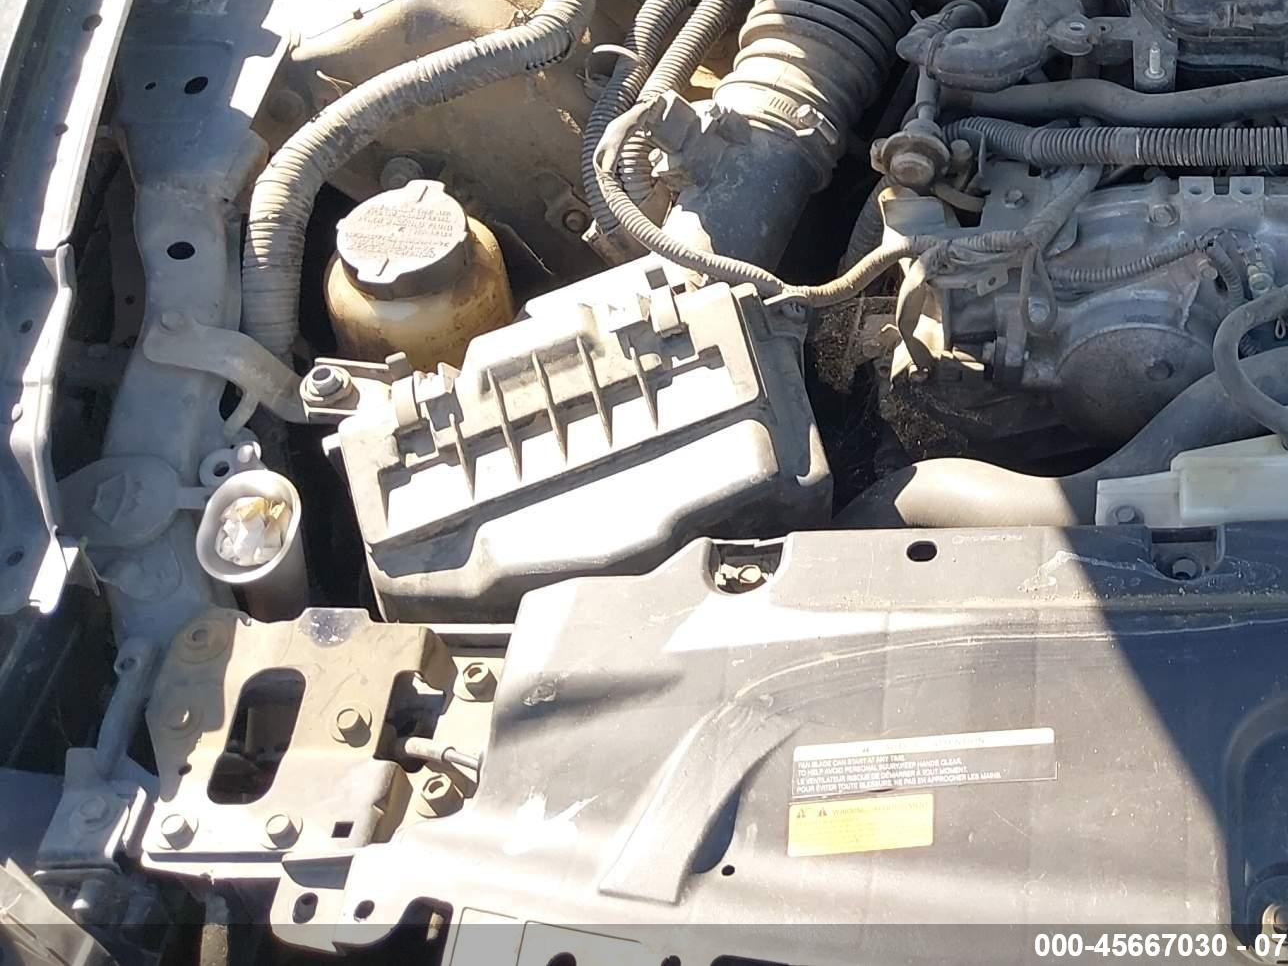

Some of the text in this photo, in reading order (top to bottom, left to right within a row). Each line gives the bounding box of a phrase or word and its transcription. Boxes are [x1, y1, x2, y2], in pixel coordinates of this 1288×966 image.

[797, 777, 805, 785] LE
[921, 767, 938, 776] TOUT
[807, 768, 823, 776] HELP
[824, 766, 843, 774] AVOID
[845, 764, 878, 773] PERSONAL
[796, 784, 814, 793] POUR
[838, 781, 857, 790] TOUTE
